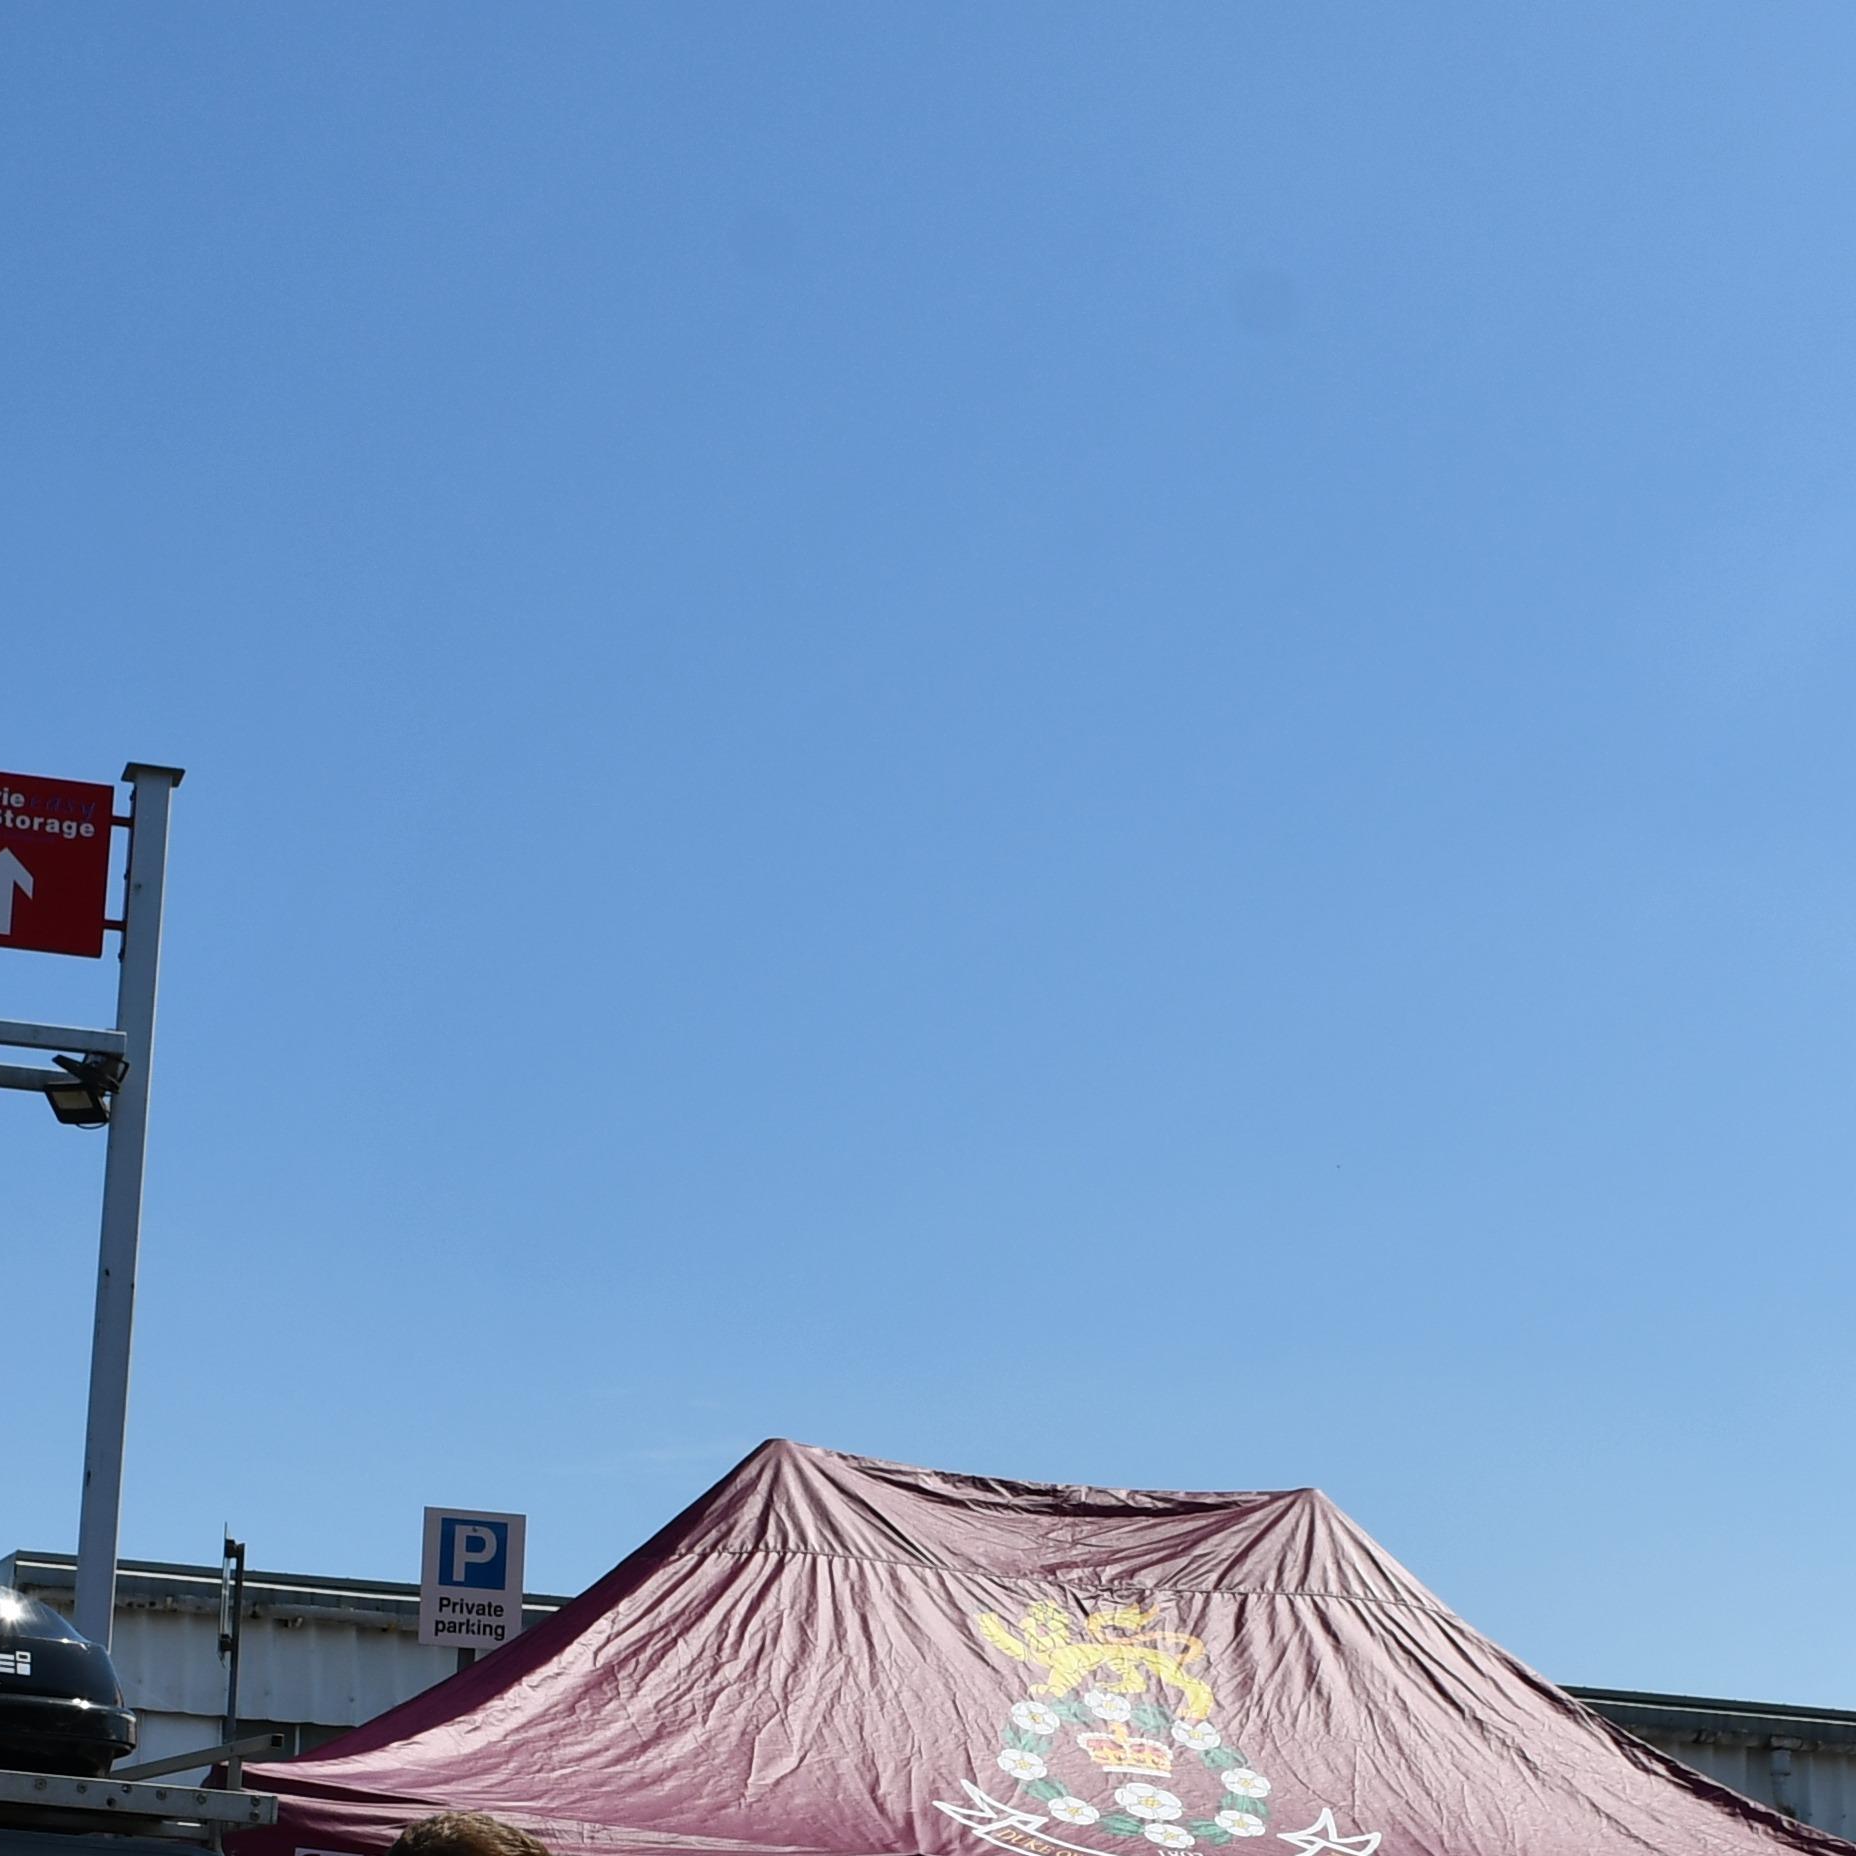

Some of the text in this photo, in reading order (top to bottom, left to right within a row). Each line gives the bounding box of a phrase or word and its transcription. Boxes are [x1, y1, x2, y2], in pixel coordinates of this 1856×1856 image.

[452, 1524, 498, 1582] P
[438, 1596, 504, 1618] Private
[434, 1618, 506, 1642] parking
[996, 1828, 1055, 1855] DUKE
